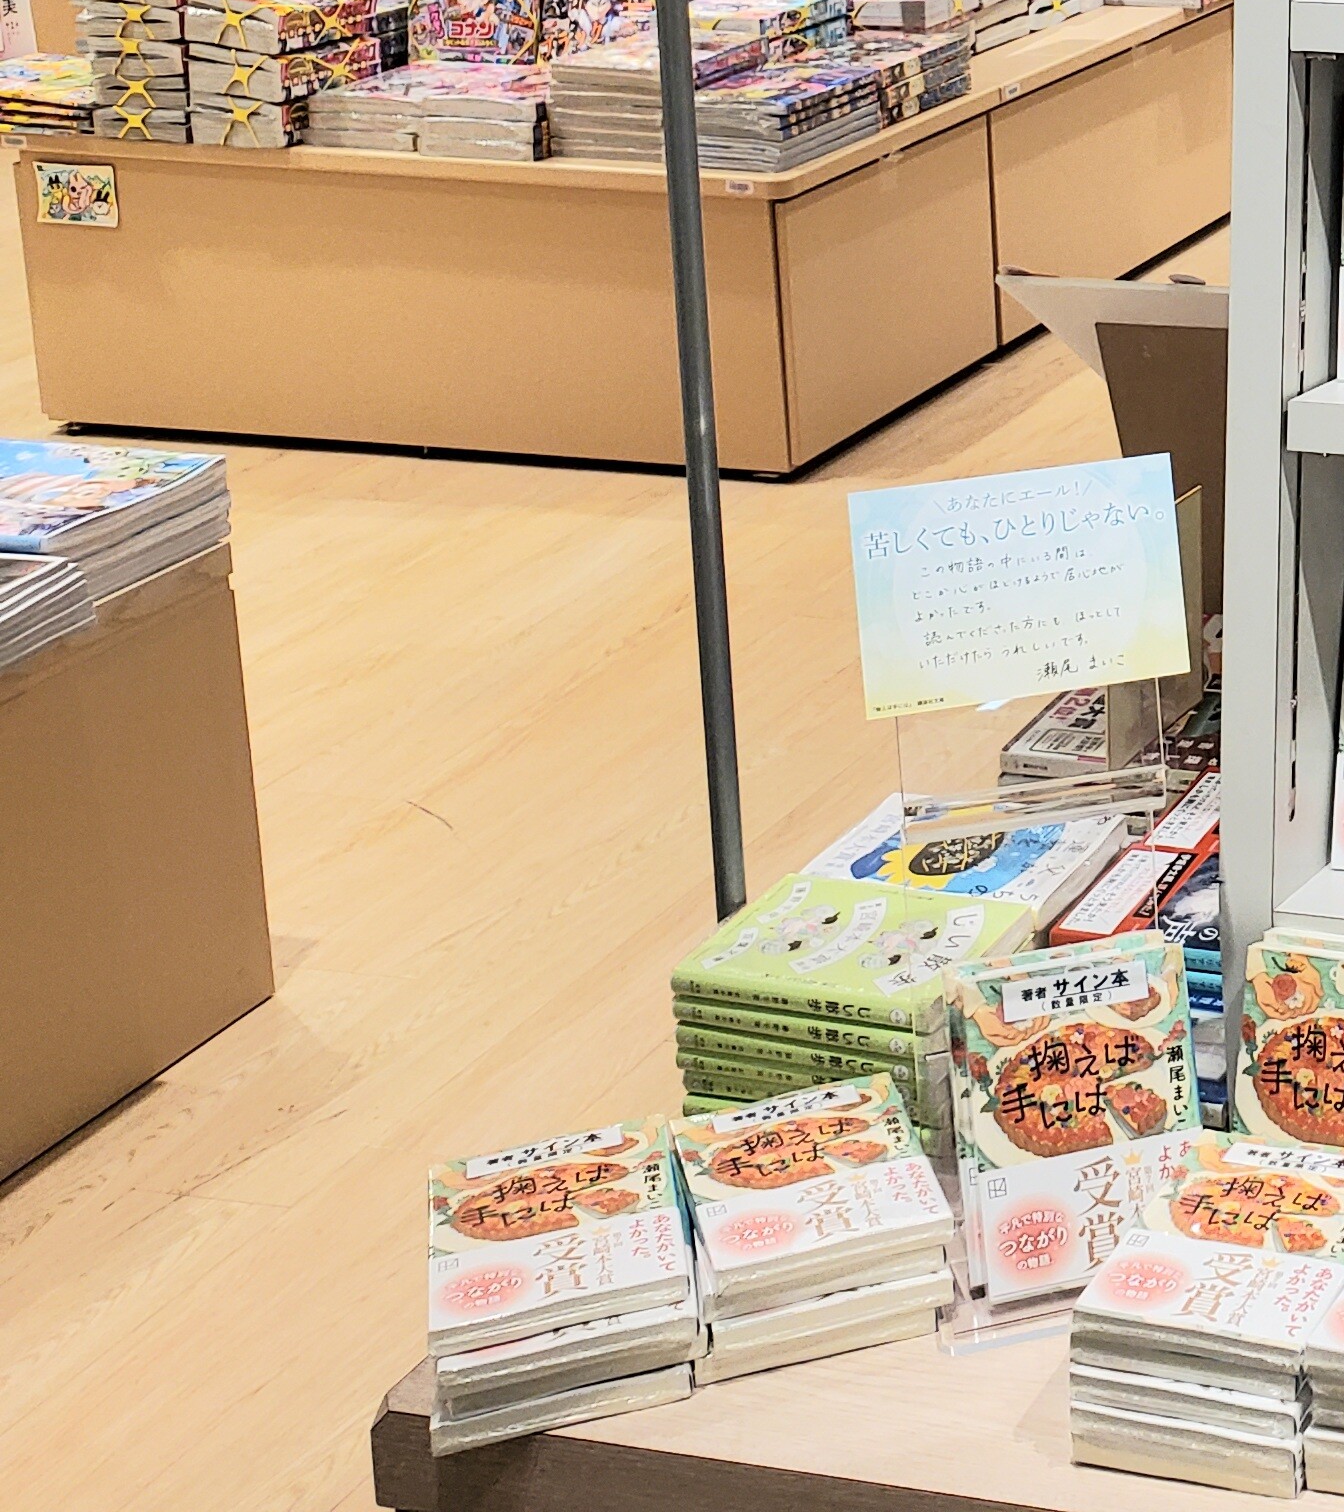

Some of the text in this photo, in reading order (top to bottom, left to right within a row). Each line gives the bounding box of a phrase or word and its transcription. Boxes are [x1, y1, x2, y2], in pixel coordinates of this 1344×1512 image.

[864, 502, 1166, 561] 苦しくても、ひとりじゃない。
[1051, 969, 1130, 996] サイン本
[1029, 1033, 1139, 1080] 掬えば
